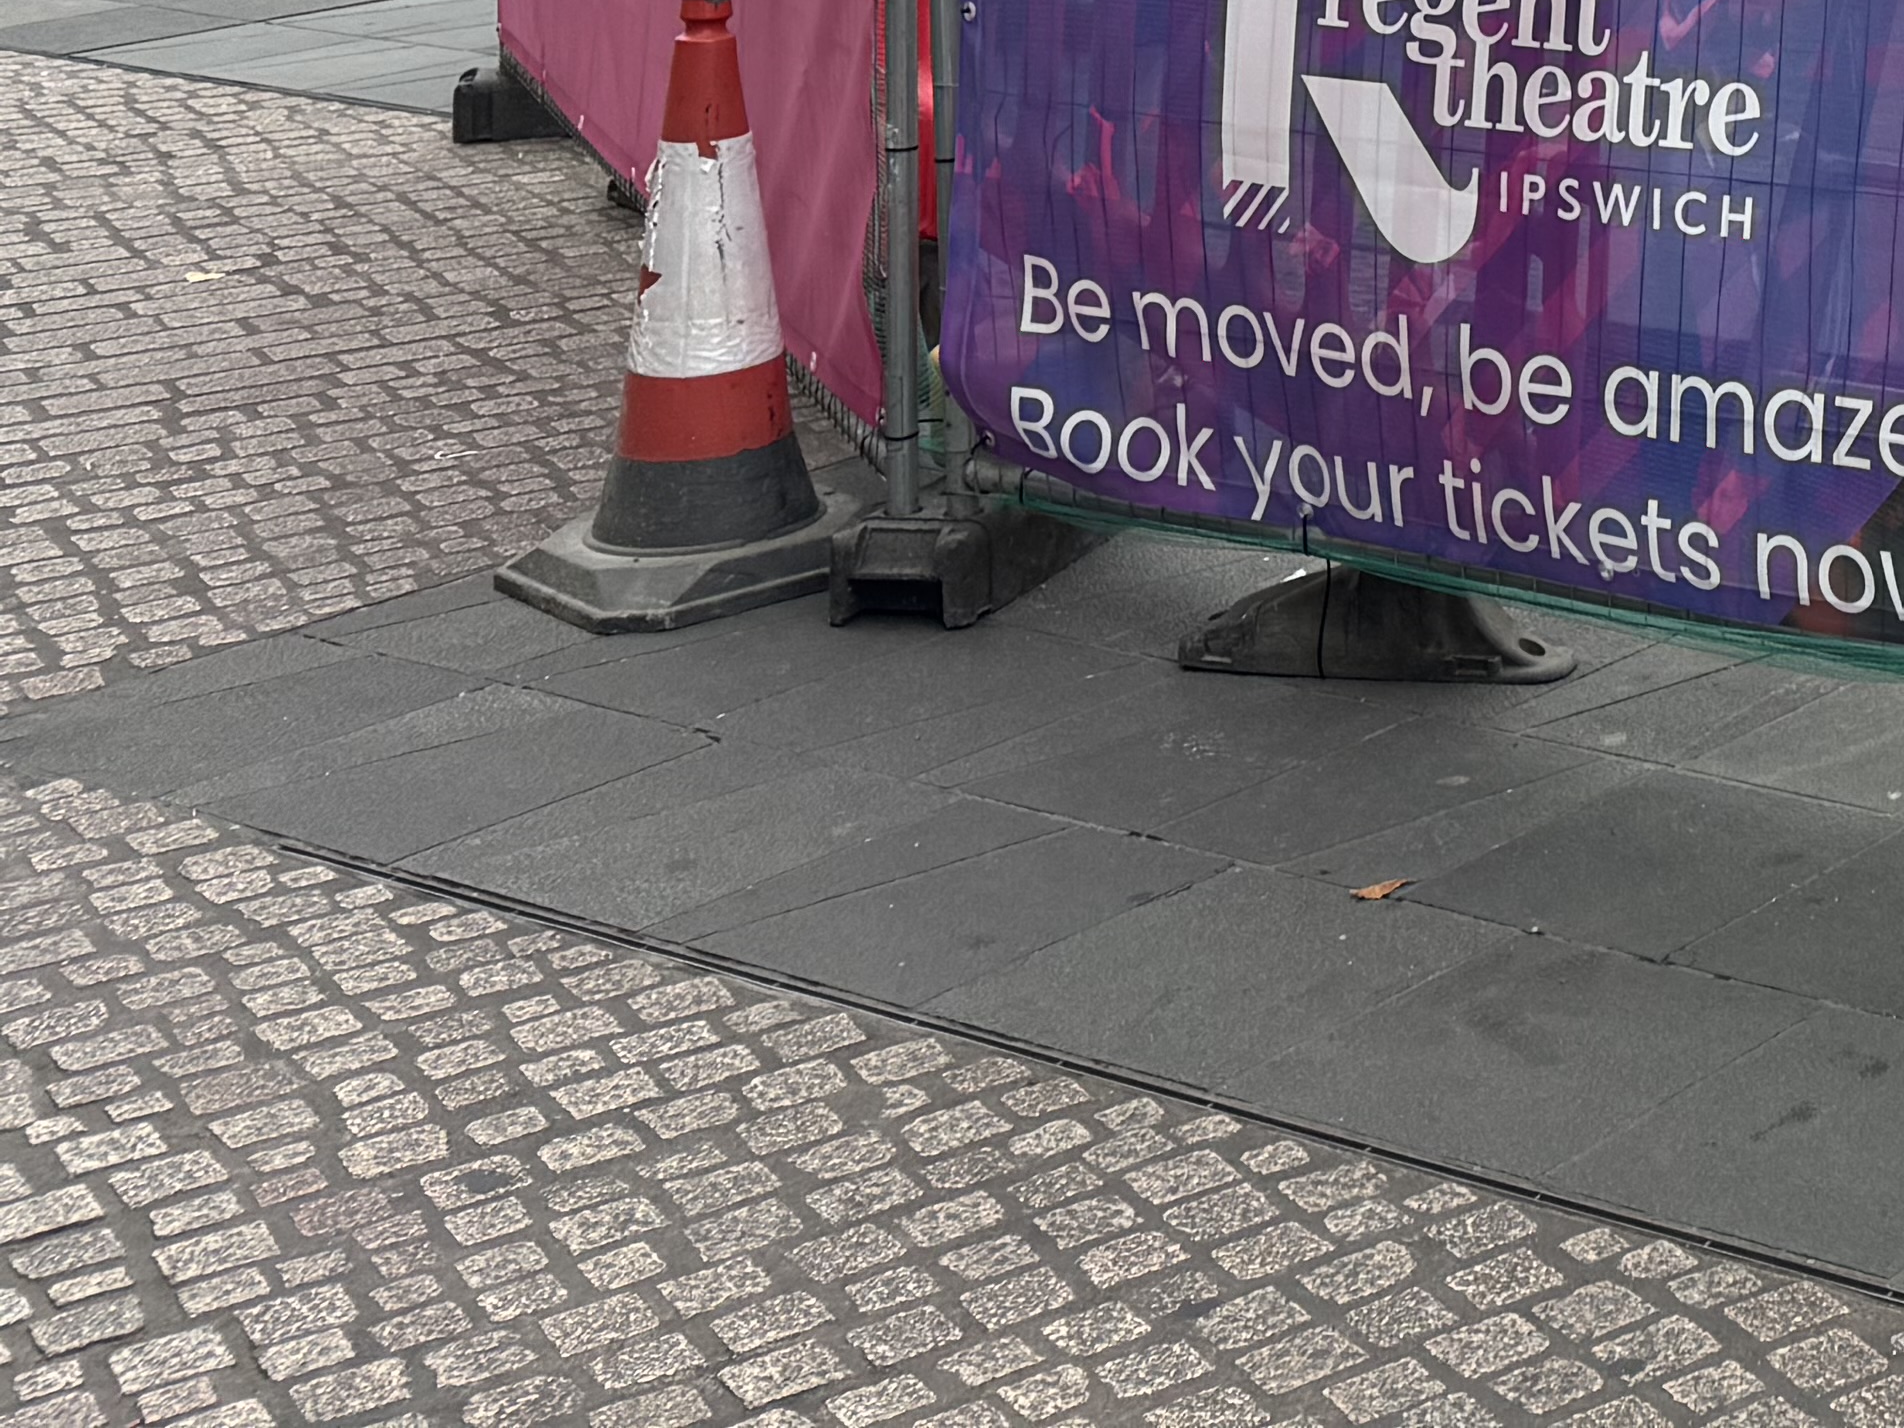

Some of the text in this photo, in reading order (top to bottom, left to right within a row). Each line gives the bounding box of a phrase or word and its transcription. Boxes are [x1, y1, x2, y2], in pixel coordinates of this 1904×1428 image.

[1430, 44, 1762, 159] theatre
[1496, 169, 1757, 243] IPSWICH
[1018, 254, 1112, 345] Be
[1133, 287, 1436, 419] moved,
[1459, 322, 1574, 426] be
[1009, 385, 1215, 493] Book
[1234, 432, 1414, 530] your
[1440, 456, 1723, 591] tickets
